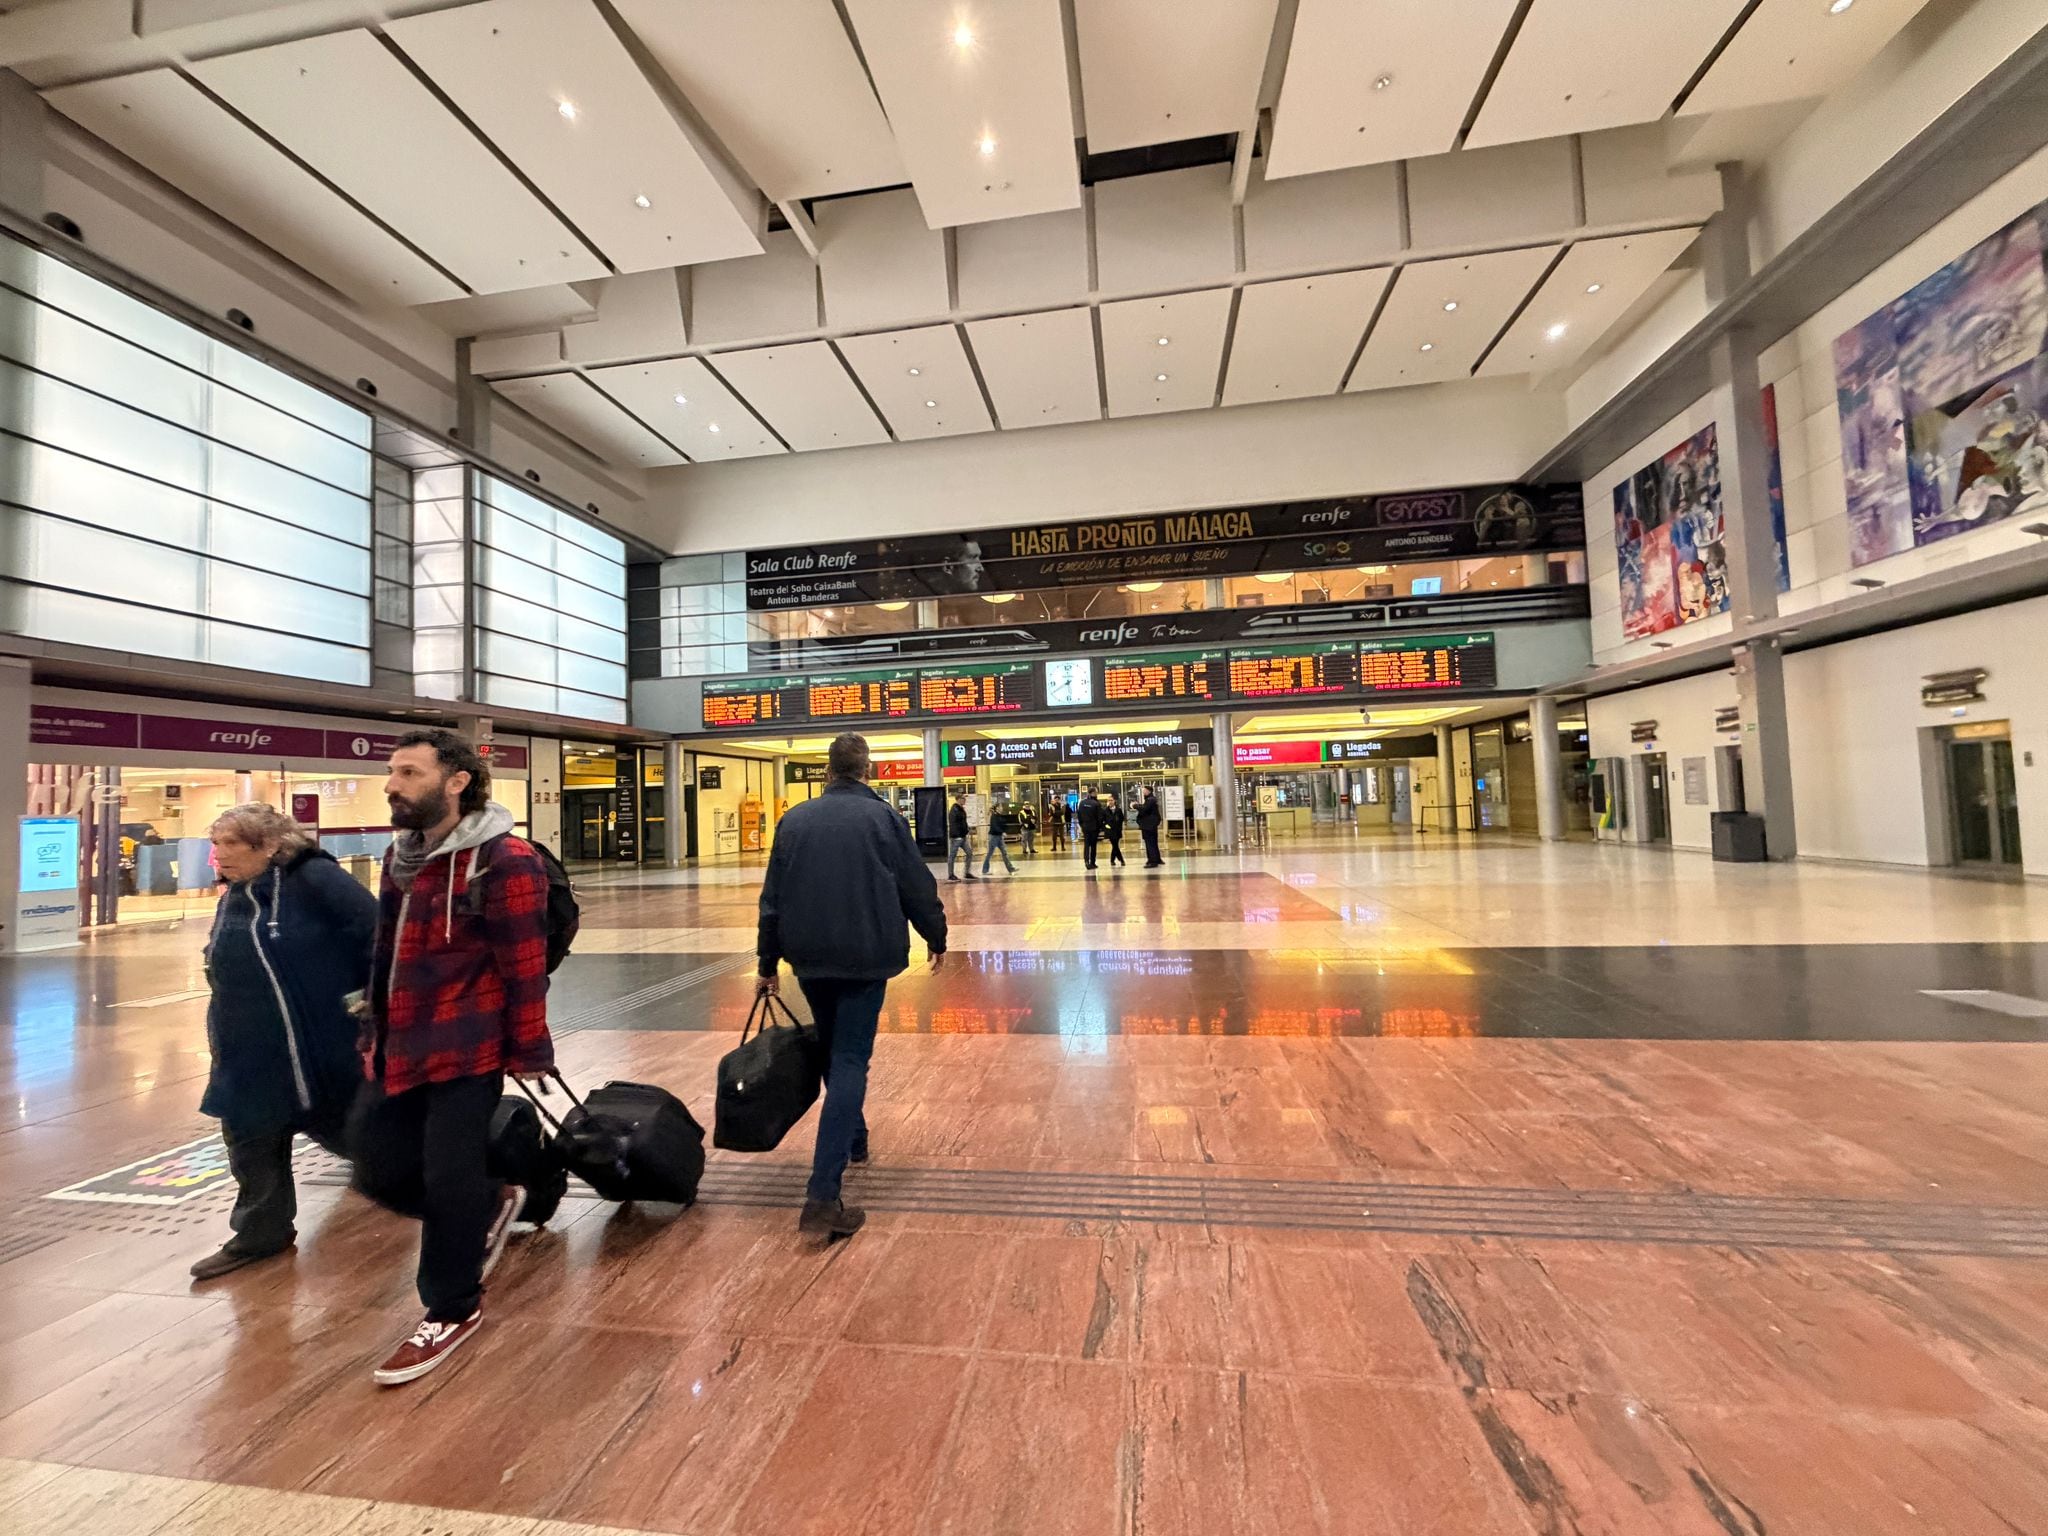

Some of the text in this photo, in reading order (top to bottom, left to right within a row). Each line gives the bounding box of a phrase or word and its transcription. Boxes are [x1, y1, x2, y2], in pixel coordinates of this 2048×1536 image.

[1302, 505, 1351, 525] renfe
[1384, 496, 1456, 521] GYPSY
[1011, 511, 1254, 556] HASTA PRONTO MÁLAGA
[1385, 536, 1417, 548] ANTONIO
[1417, 534, 1454, 545] BANDERAS
[749, 551, 857, 574] Sala Club Renfe
[1107, 556, 1121, 569] DE
[1174, 551, 1188, 563] UN
[1192, 547, 1228, 562] SUEÑO
[749, 580, 857, 597] Teatro del Soho CaixaBank
[767, 592, 840, 606] Antonio Banderas
[1080, 622, 1139, 645] renfe
[1168, 624, 1203, 637] tren
[210, 728, 272, 750] renfe
[1088, 734, 1183, 748] Control de equipajes
[1346, 742, 1382, 751] Llegadas
[971, 743, 997, 761] 1-8
[1000, 742, 1029, 752] Acceso
[1039, 740, 1058, 750] vías
[1000, 751, 1035, 759] PLATFORMS
[1118, 746, 1146, 754] CONTROL
[1236, 748, 1271, 757] No pasar
[907, 763, 925, 771] pasa
